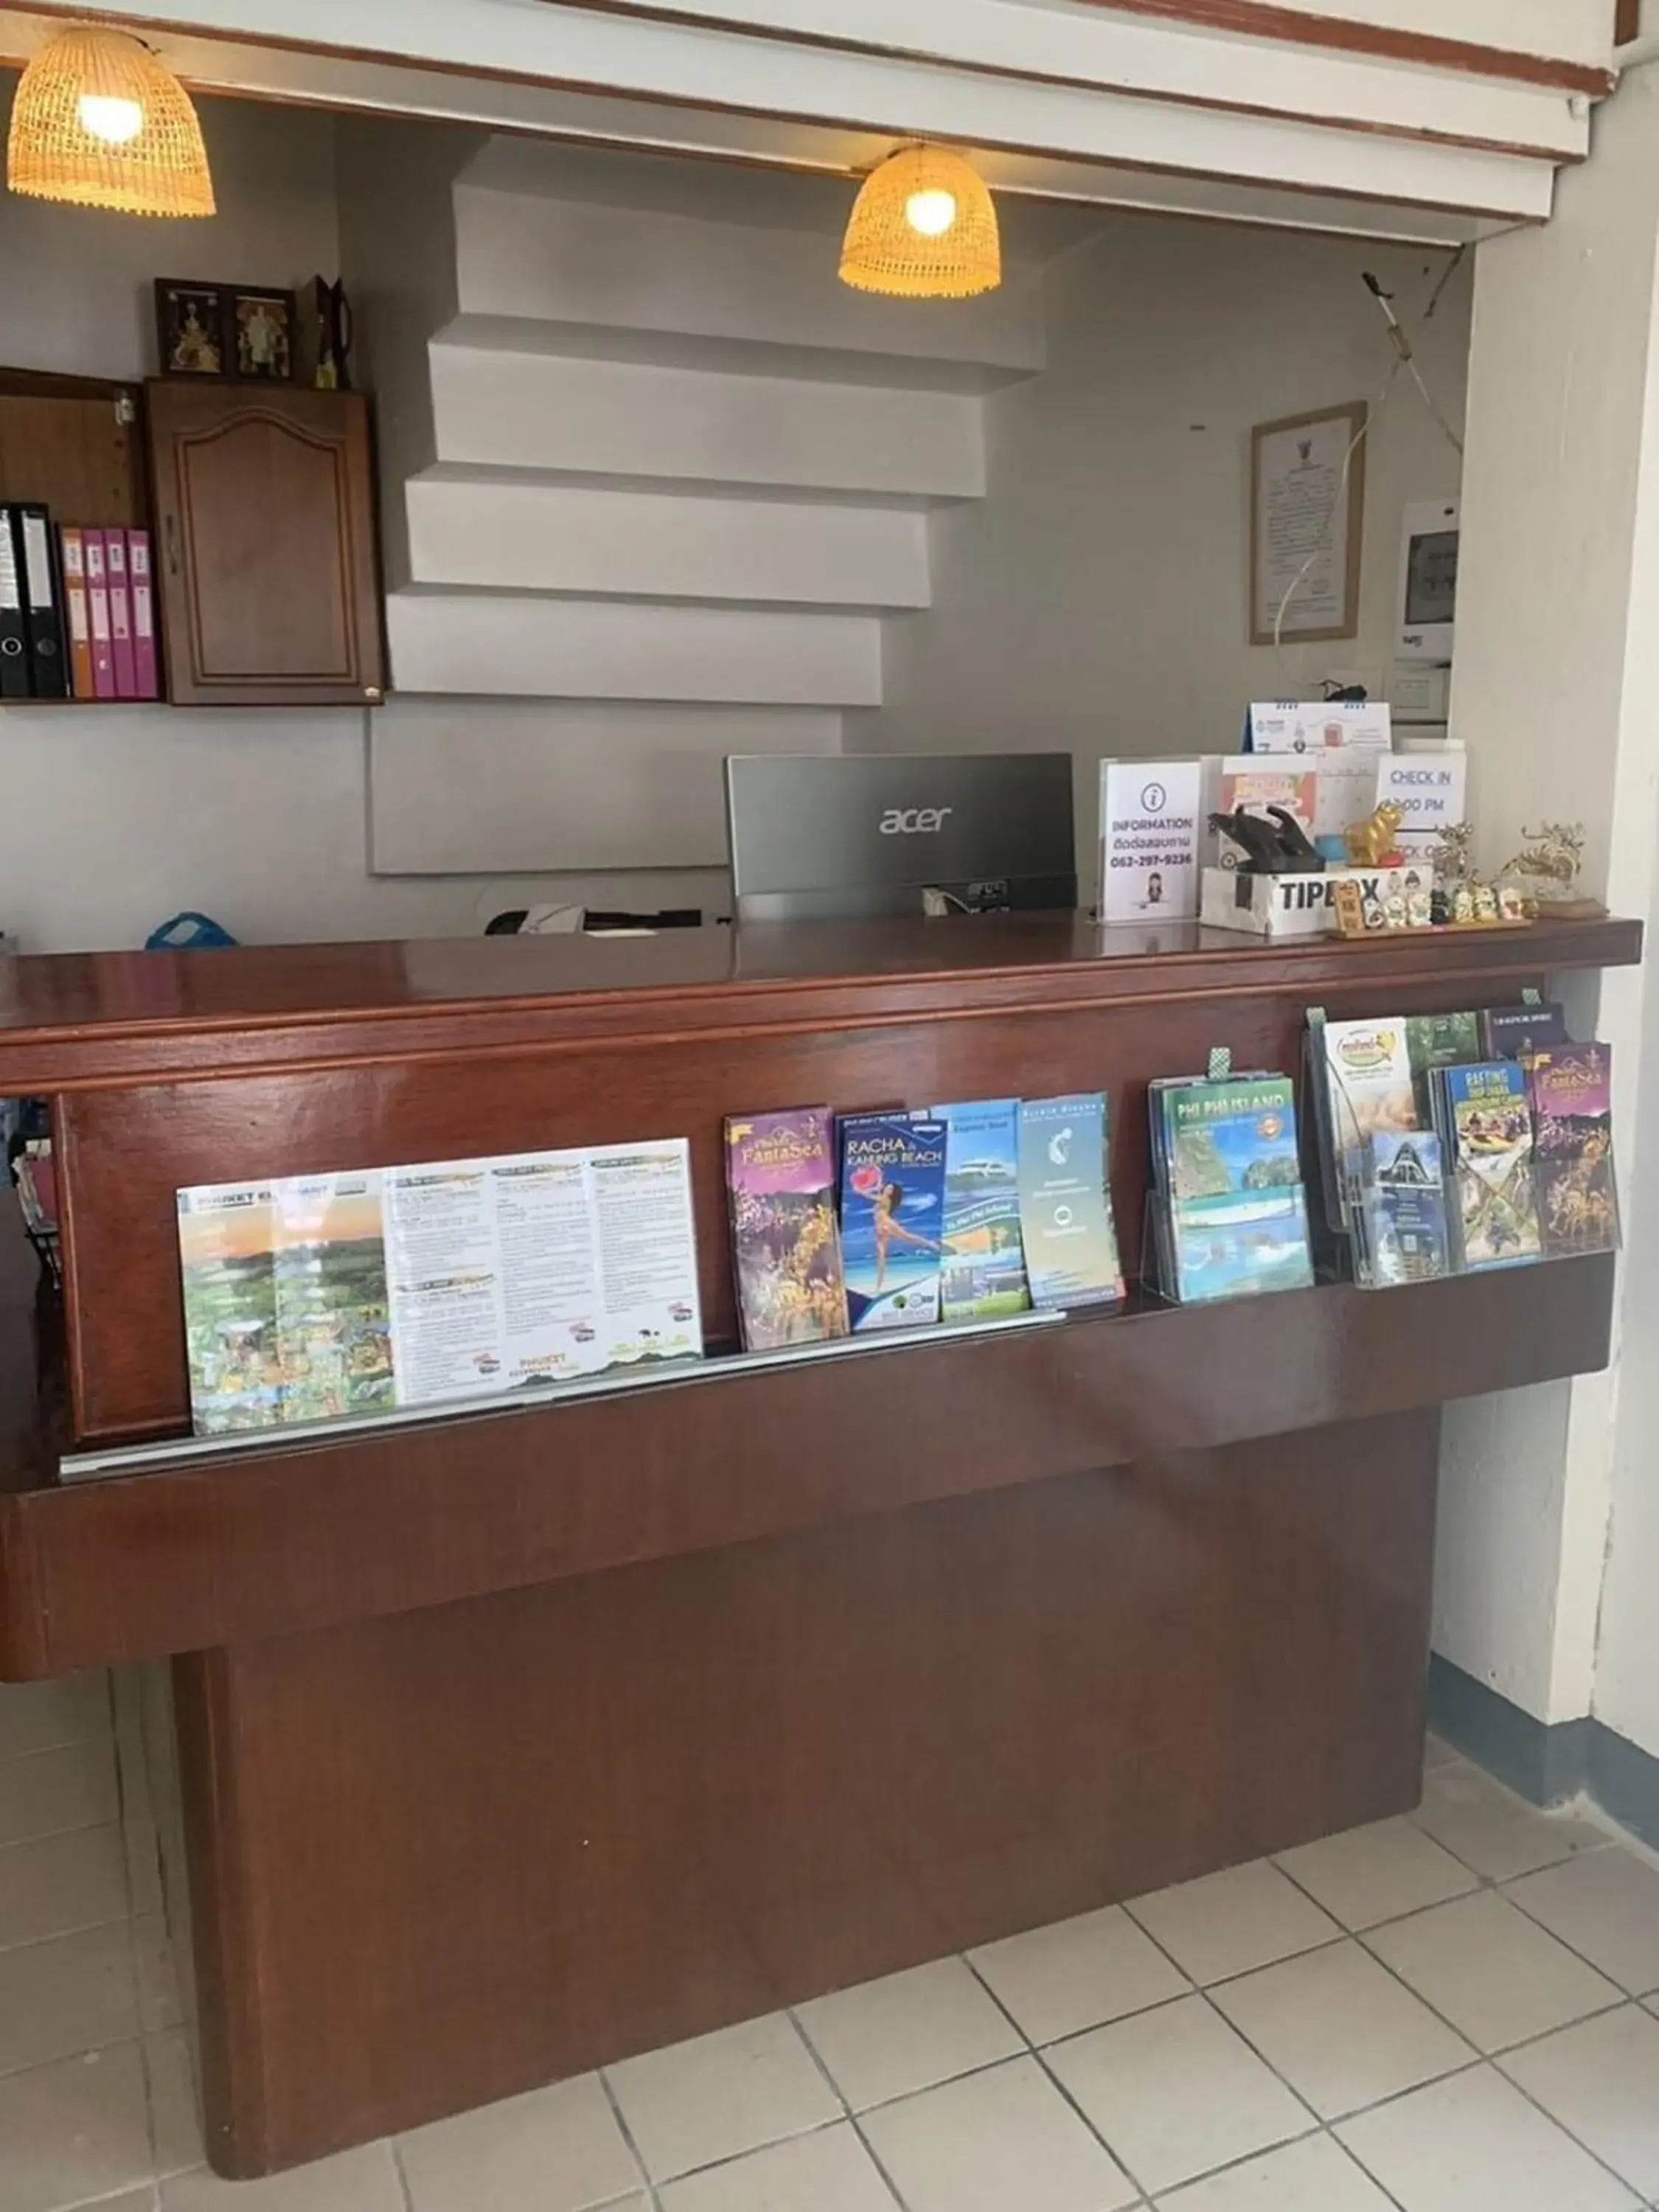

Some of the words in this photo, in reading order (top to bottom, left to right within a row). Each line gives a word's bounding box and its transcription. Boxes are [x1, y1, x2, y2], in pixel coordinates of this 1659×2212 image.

[1391, 769, 1433, 785] CHECK
[1438, 771, 1451, 785] IN
[1424, 799, 1444, 811] PM
[879, 807, 953, 835] acer
[1112, 817, 1193, 832] INFORMATION
[1113, 835, 1191, 850] ติดต่อสอบถาม
[847, 1138, 905, 1155] RACHA
[902, 1150, 943, 1164] BEACH
